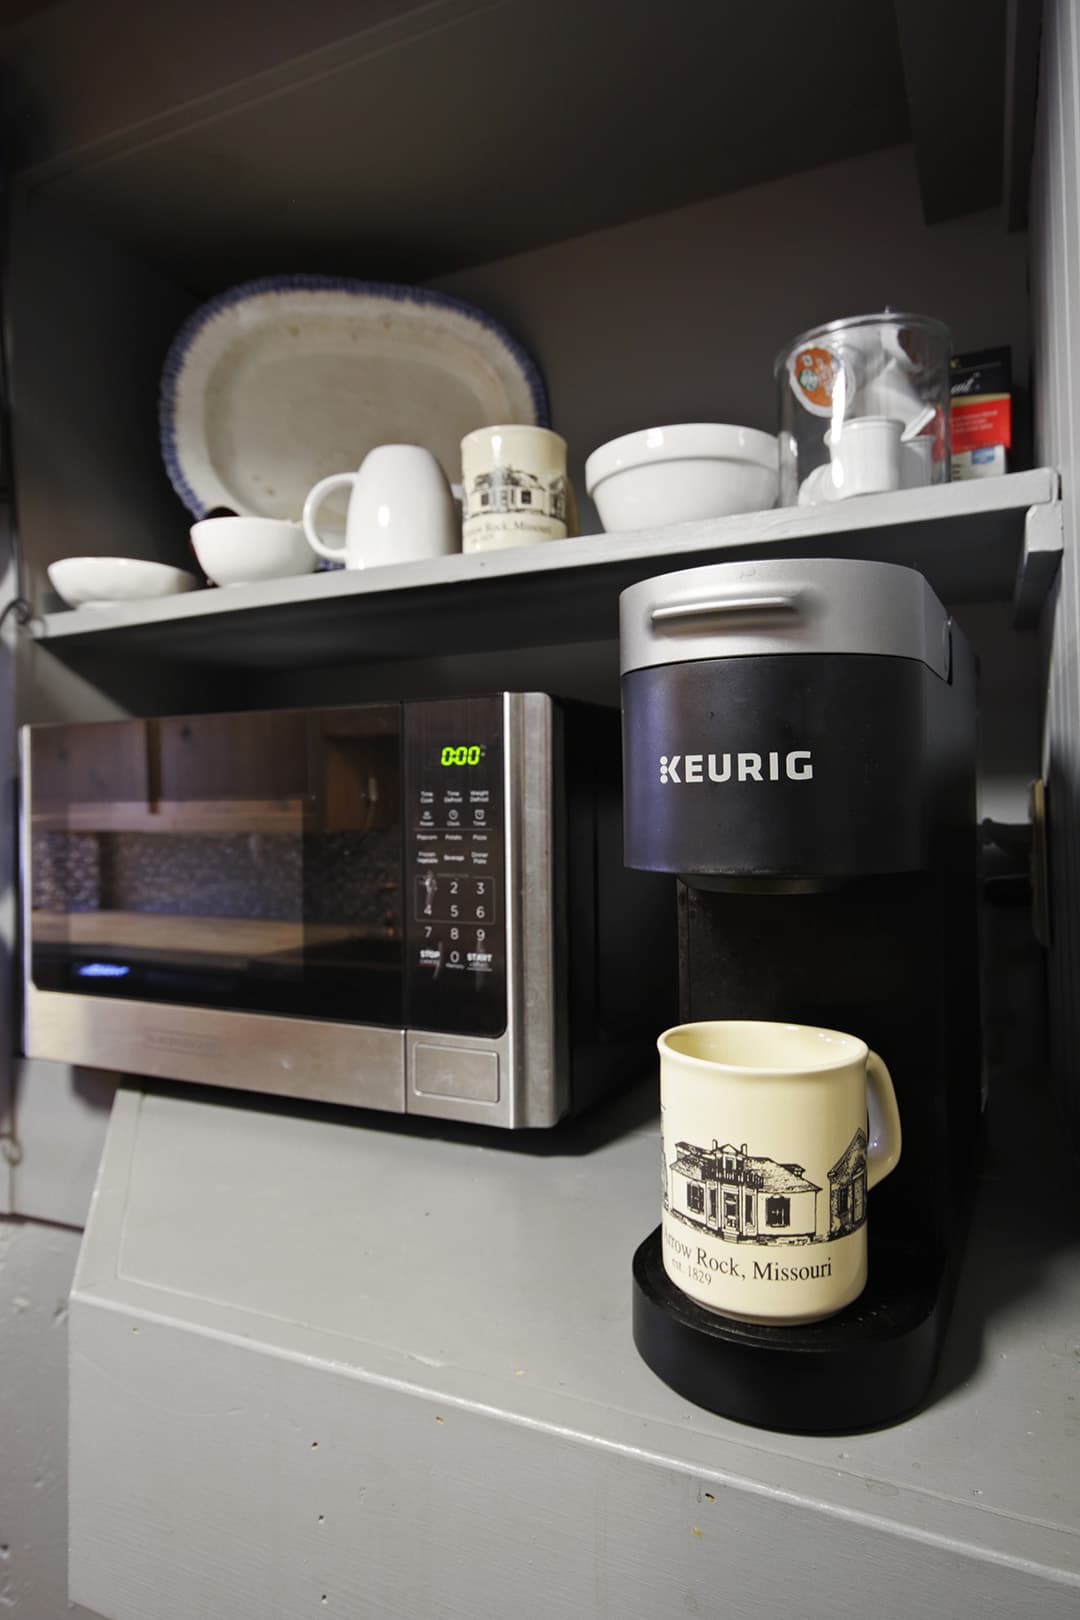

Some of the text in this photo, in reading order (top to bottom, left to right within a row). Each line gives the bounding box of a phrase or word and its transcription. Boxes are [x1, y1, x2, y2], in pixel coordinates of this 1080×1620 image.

[441, 746, 481, 766] 0:00
[660, 751, 813, 784] KEURIG
[450, 881, 459, 894] 2
[476, 882, 485, 895] 3
[423, 904, 432, 916] 4
[450, 904, 459, 918] 5
[476, 906, 485, 919] 6
[424, 926, 433, 938] 7
[450, 928, 459, 940] 8
[476, 928, 485, 941] 9
[420, 949, 440, 959] STOP
[450, 951, 460, 963] 0
[466, 952, 493, 962] START
[696, 1247, 746, 1281] Rock,
[752, 1257, 832, 1281] Missouri
[688, 1264, 712, 1286] 1829
